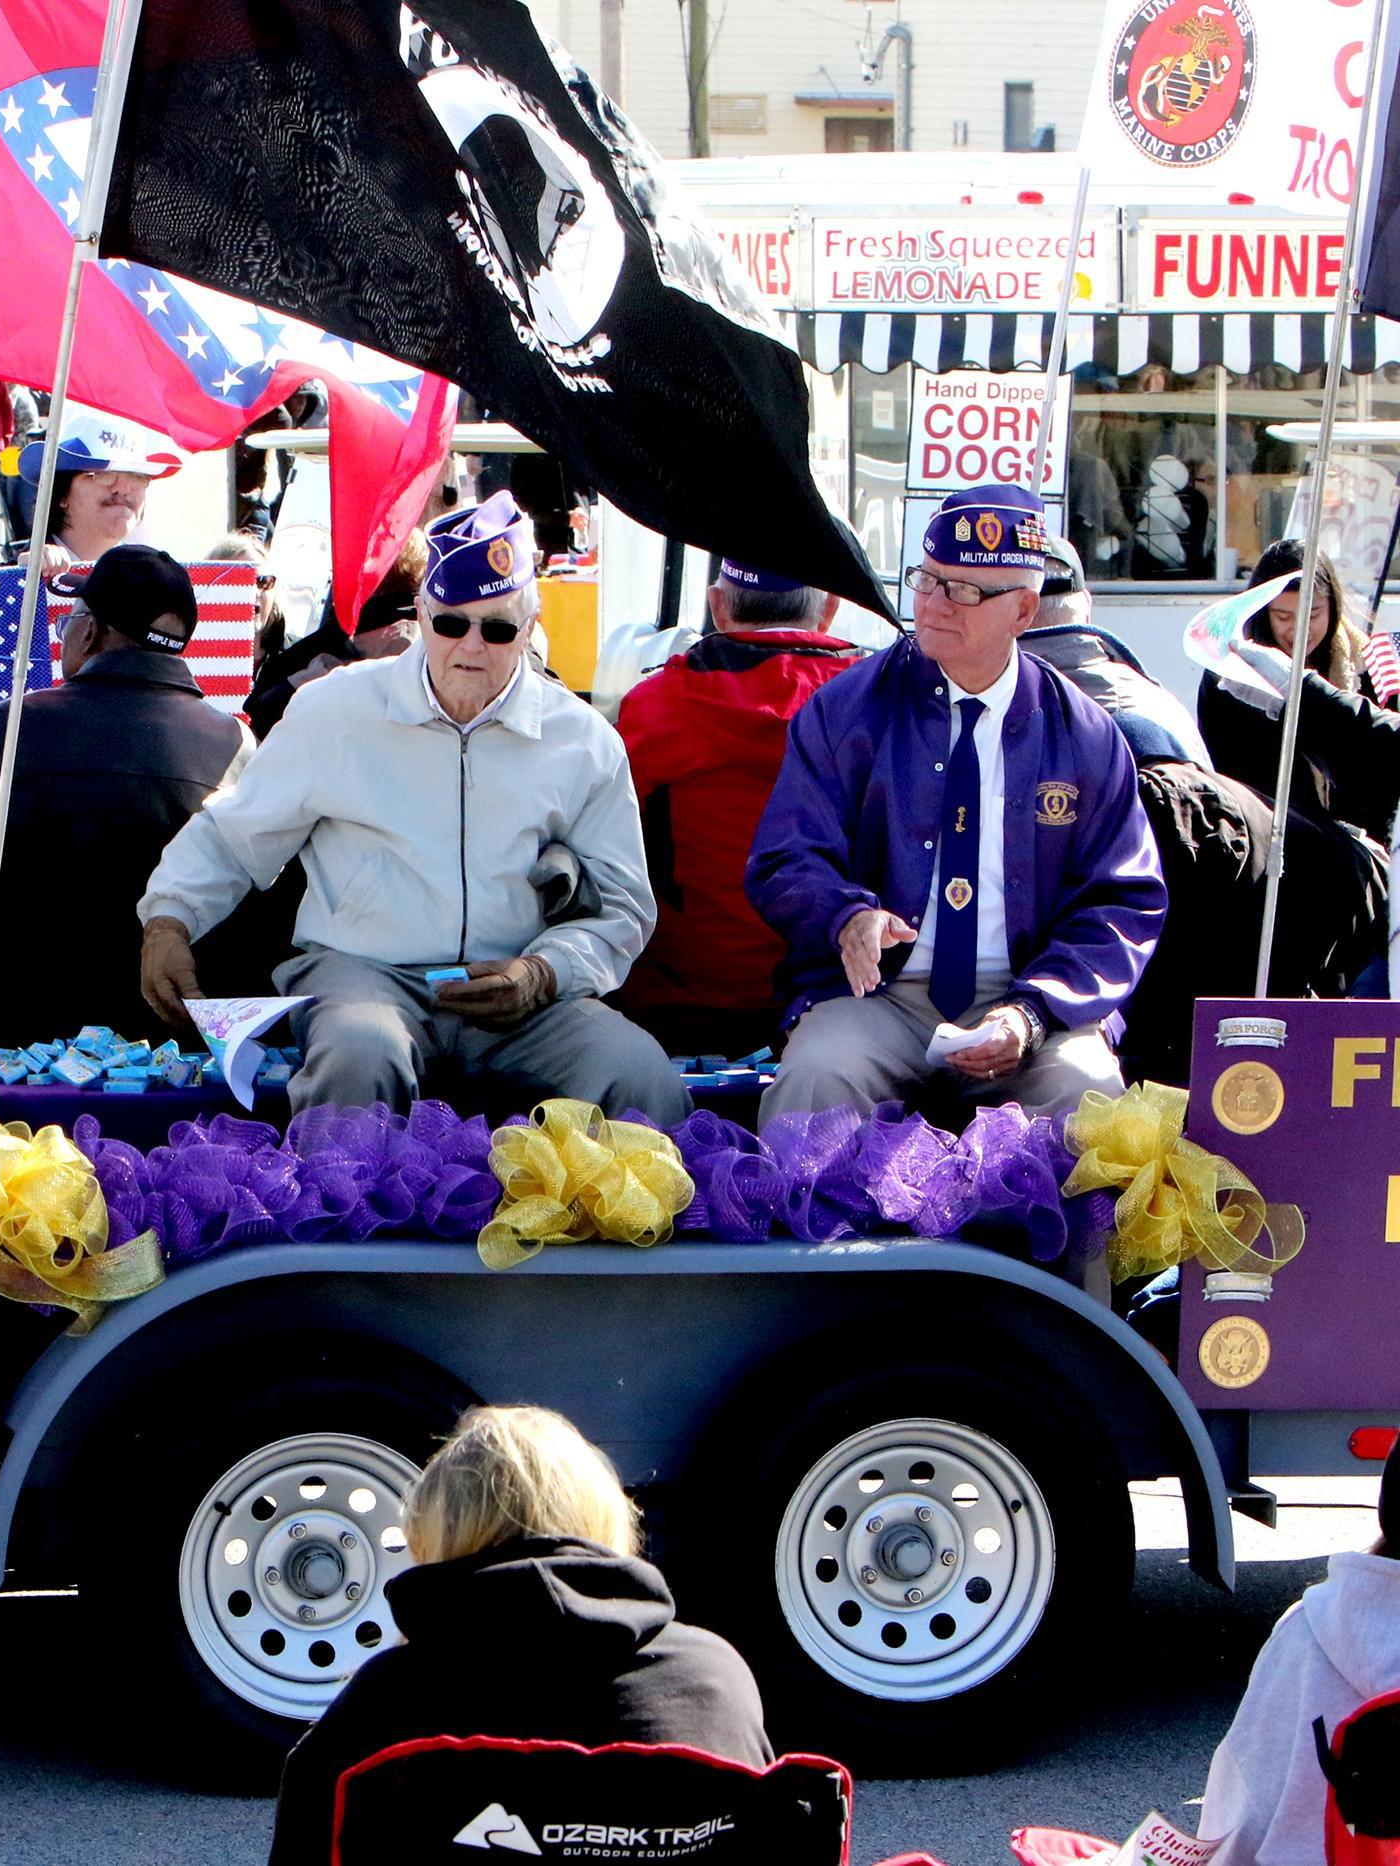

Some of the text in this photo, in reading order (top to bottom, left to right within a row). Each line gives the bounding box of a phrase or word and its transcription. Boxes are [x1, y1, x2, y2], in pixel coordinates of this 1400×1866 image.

[1115, 95, 1238, 163] MARINE CORPS
[717, 232, 791, 296] AKES
[825, 229, 1096, 267] Fresh Squeezed
[1152, 234, 1346, 298] FUNNE
[831, 270, 1043, 300] LEMONADE
[925, 379, 1057, 404] Hand Dippe
[923, 402, 1055, 443] CORN
[921, 442, 1053, 484] DOGS
[960, 551, 999, 564] MILITARY
[1001, 552, 1024, 565] ORDER
[478, 577, 514, 596] MILITARY
[743, 571, 759, 584] USA
[146, 631, 185, 650] PURPLE HEART
[1331, 1037, 1400, 1108] F
[562, 1838, 714, 1858] OUTDOOR EQUIPMENT
